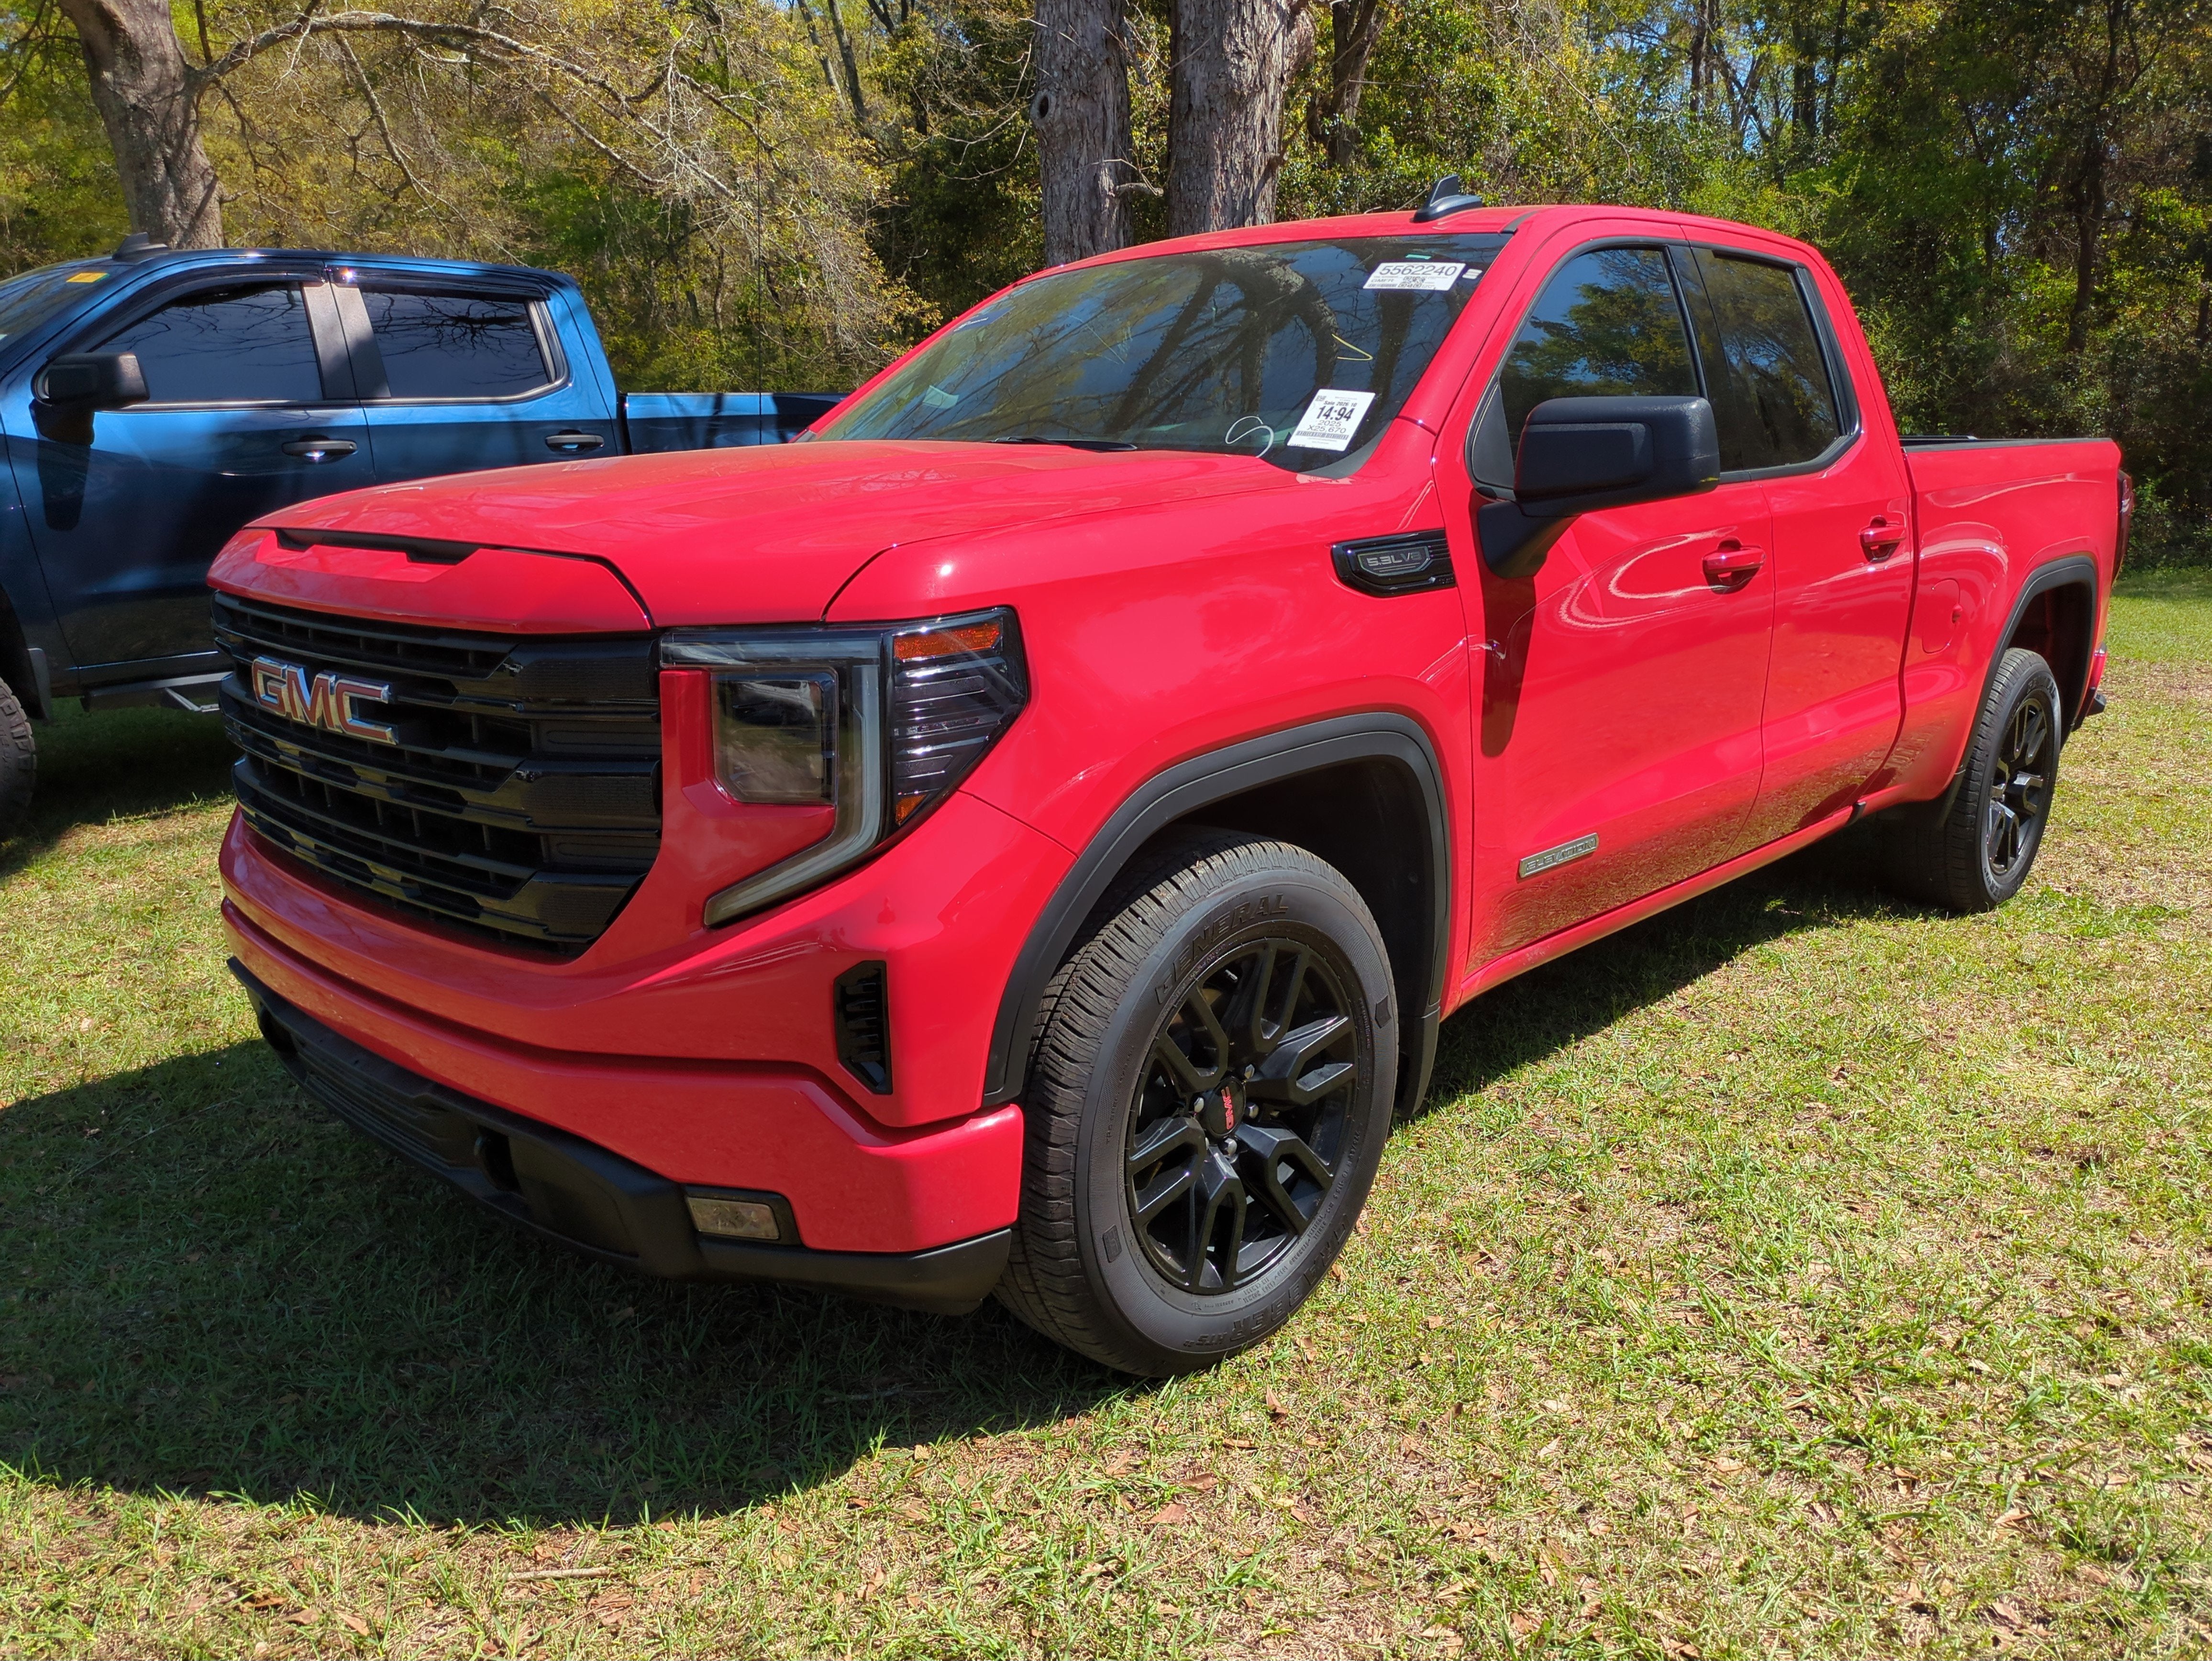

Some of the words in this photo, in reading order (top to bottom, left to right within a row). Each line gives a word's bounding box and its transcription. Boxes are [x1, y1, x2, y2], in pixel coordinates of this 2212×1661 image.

[1380, 265, 1457, 276] 5562240
[252, 656, 398, 745] GMC
[1155, 893, 1289, 1004] GENERAL
[1221, 1086, 1234, 1129] GMC
